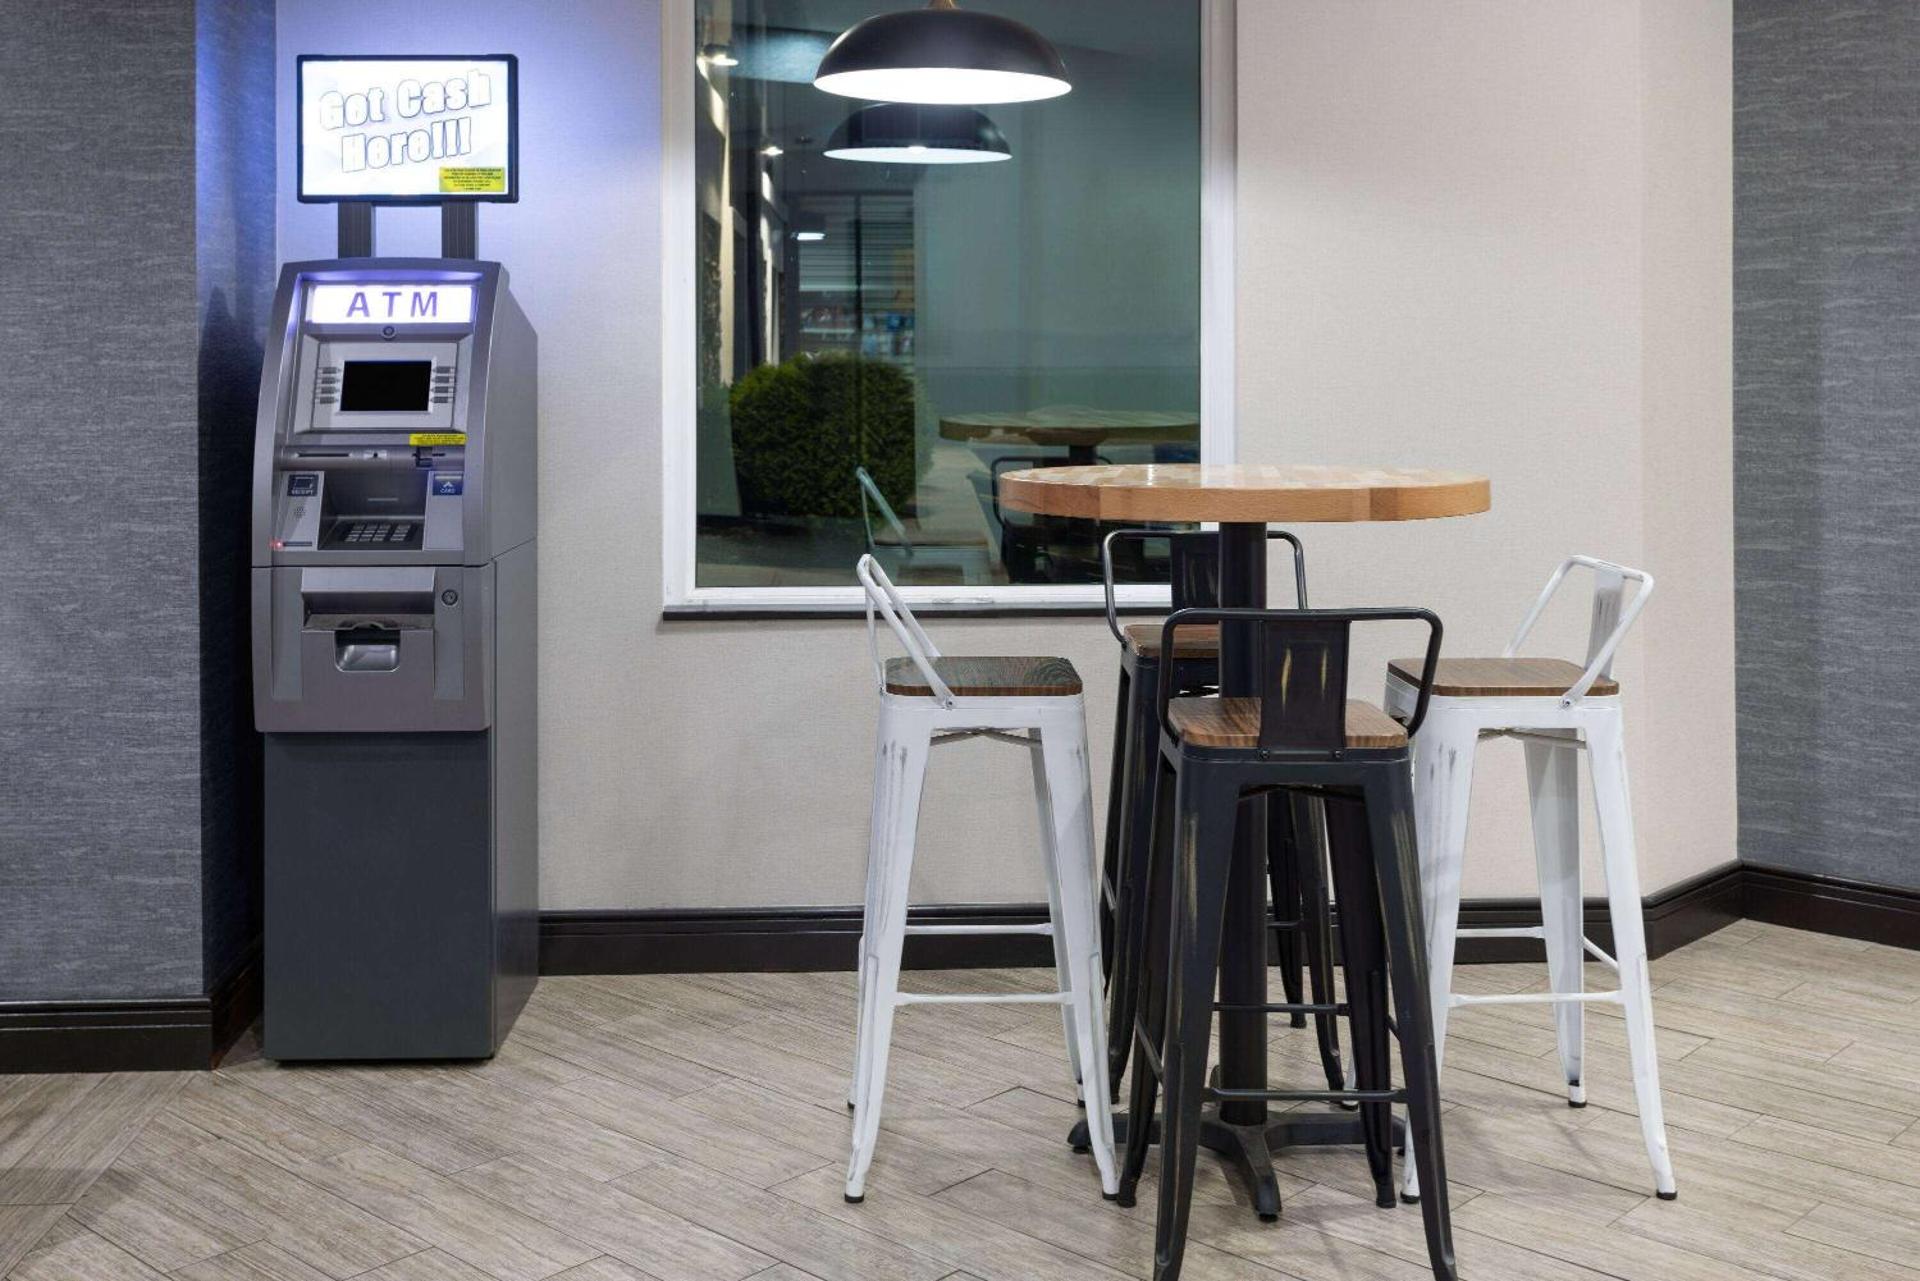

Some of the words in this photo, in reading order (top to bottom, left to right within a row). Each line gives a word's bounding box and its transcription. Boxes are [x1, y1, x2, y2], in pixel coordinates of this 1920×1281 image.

[320, 87, 385, 130] Got
[396, 69, 492, 118] Cash
[341, 117, 472, 173] Here!!!
[346, 291, 438, 318] ATM
